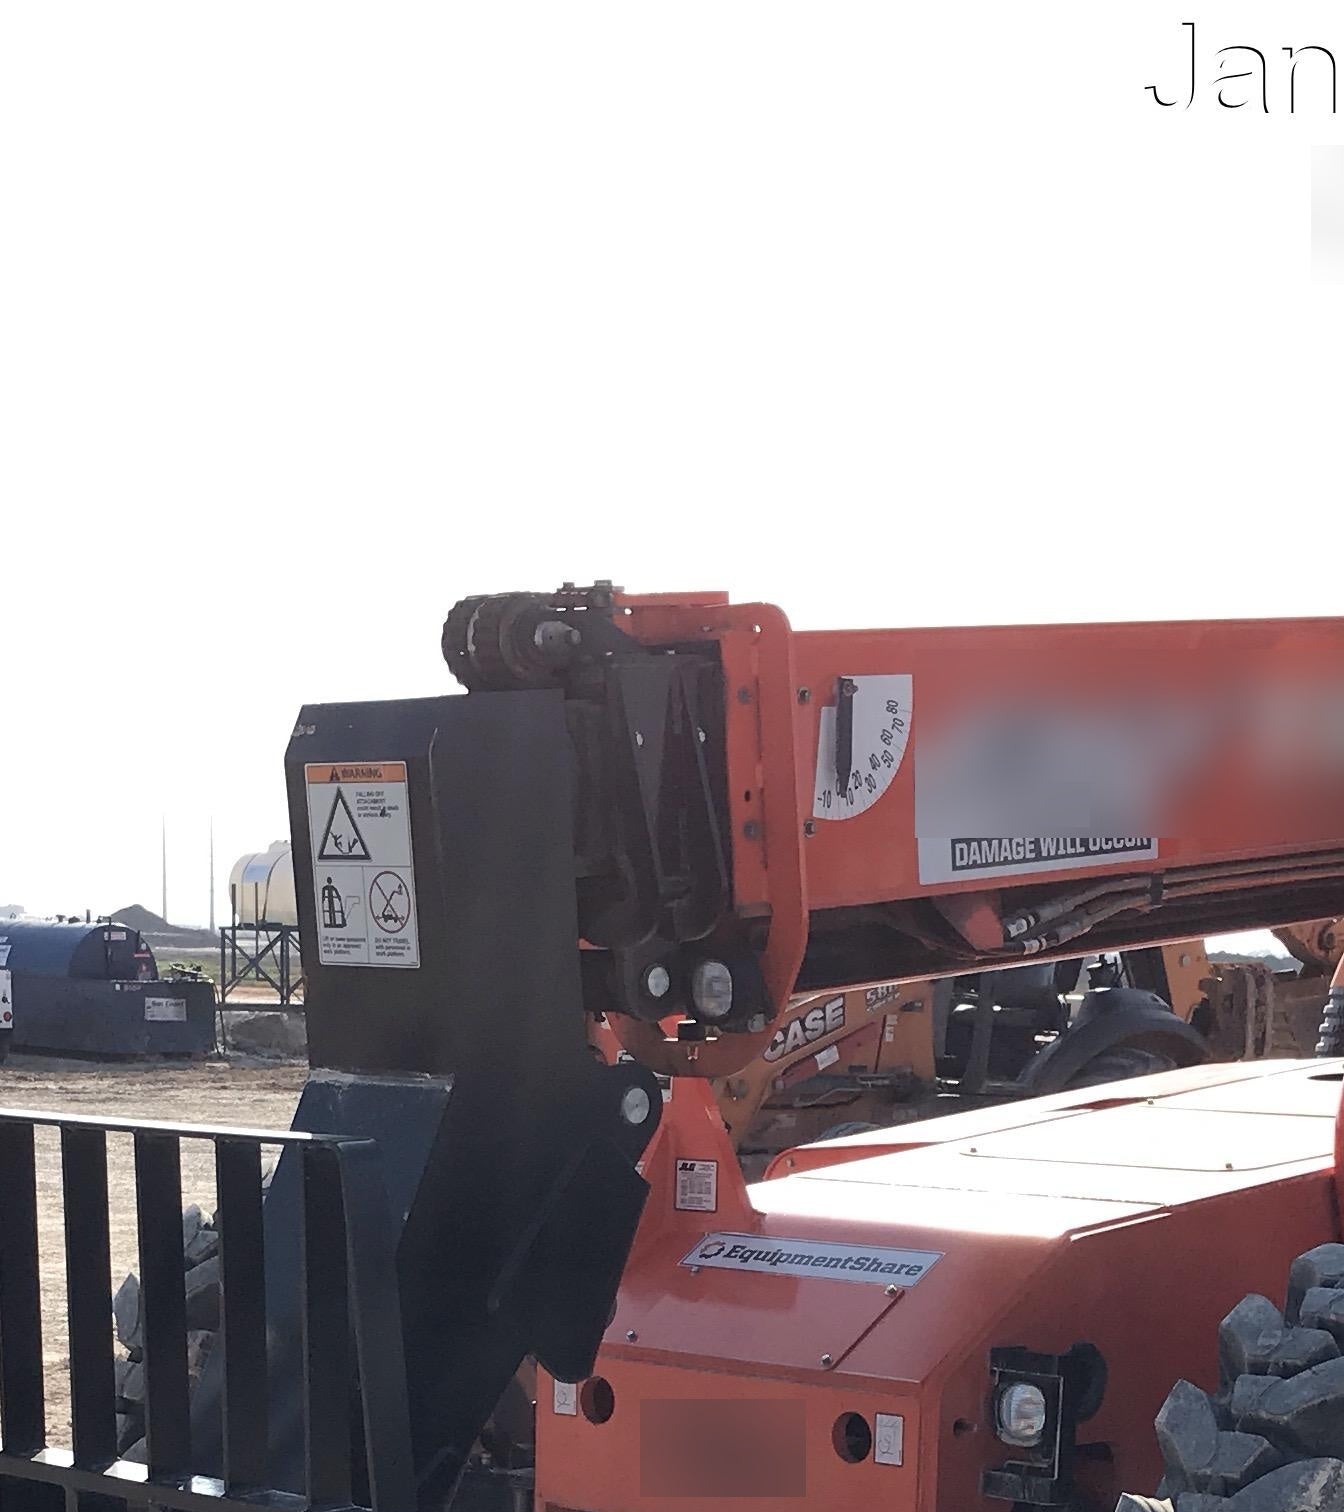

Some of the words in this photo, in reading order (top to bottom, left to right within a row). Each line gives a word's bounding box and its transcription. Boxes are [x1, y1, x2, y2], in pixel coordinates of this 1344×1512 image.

[886, 699, 899, 715] 80
[891, 717, 905, 734] 70
[880, 728, 894, 746] 60
[868, 753, 881, 771] 40
[880, 749, 895, 768] 50
[851, 769, 863, 790] 20
[864, 773, 877, 794] 30
[817, 789, 832, 809] -10
[955, 838, 1036, 867] DAMAGE
[1040, 838, 1086, 857] WILL
[763, 996, 844, 1062] CASE
[722, 1244, 924, 1277] EquipmentShare
